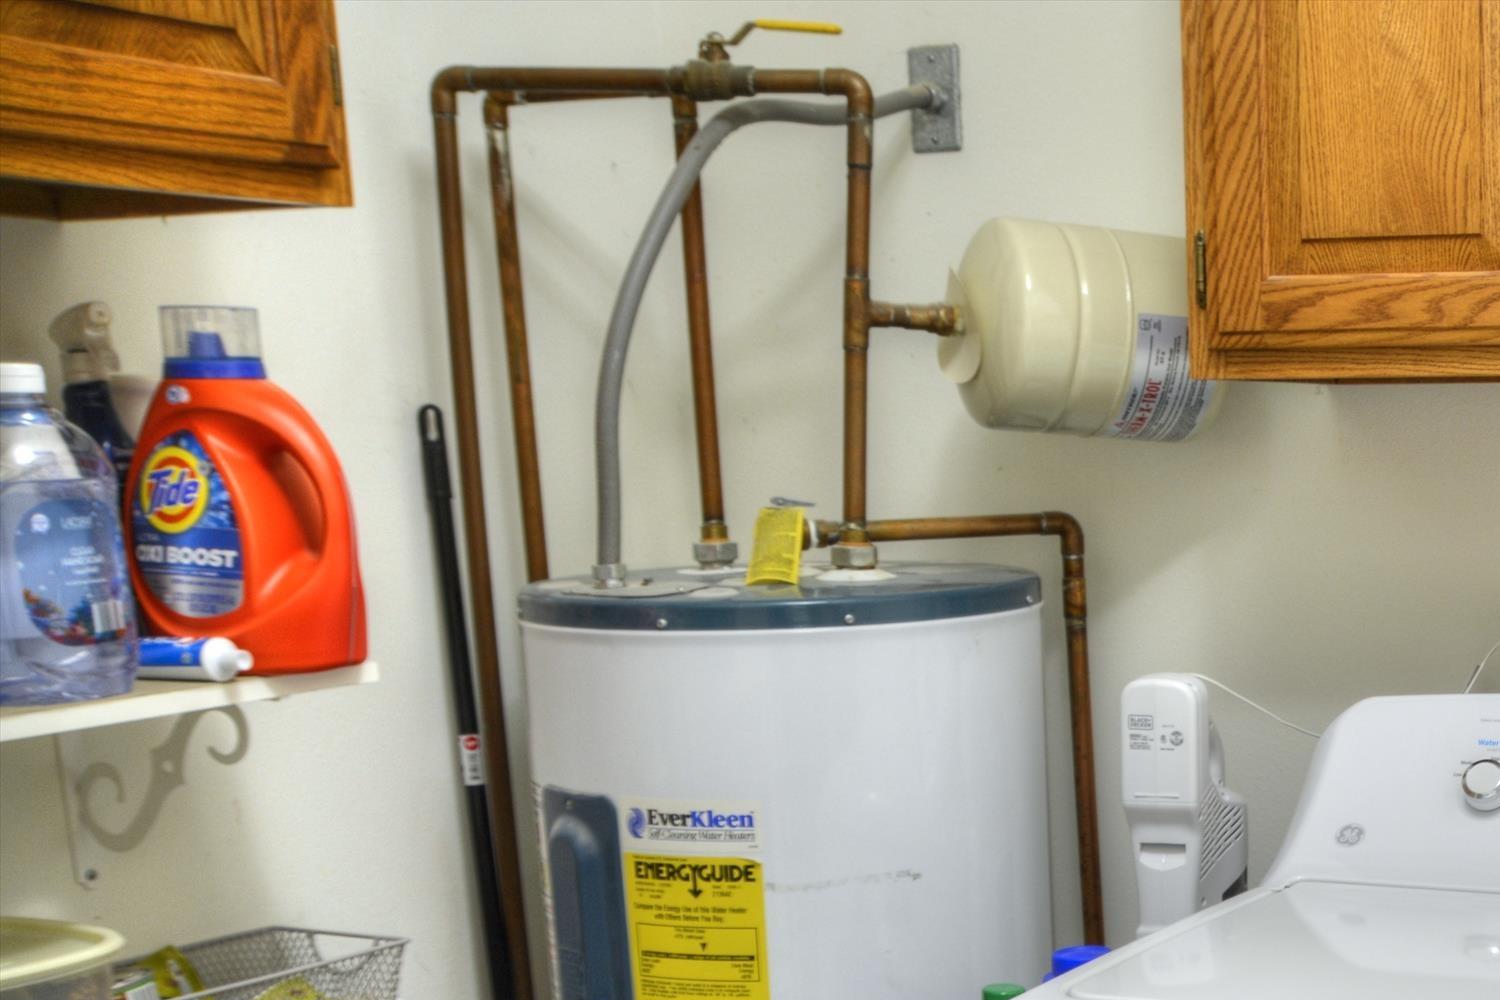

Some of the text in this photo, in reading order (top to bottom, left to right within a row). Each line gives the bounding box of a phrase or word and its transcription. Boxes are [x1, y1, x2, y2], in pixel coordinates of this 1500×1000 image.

[145, 465, 199, 516] Tide
[135, 545, 238, 568] OXI BOOST
[648, 809, 754, 828] EverKleen
[648, 828, 755, 841] Self-Cleaning Water Heaters
[634, 861, 756, 884] ENERGYGUIDE
